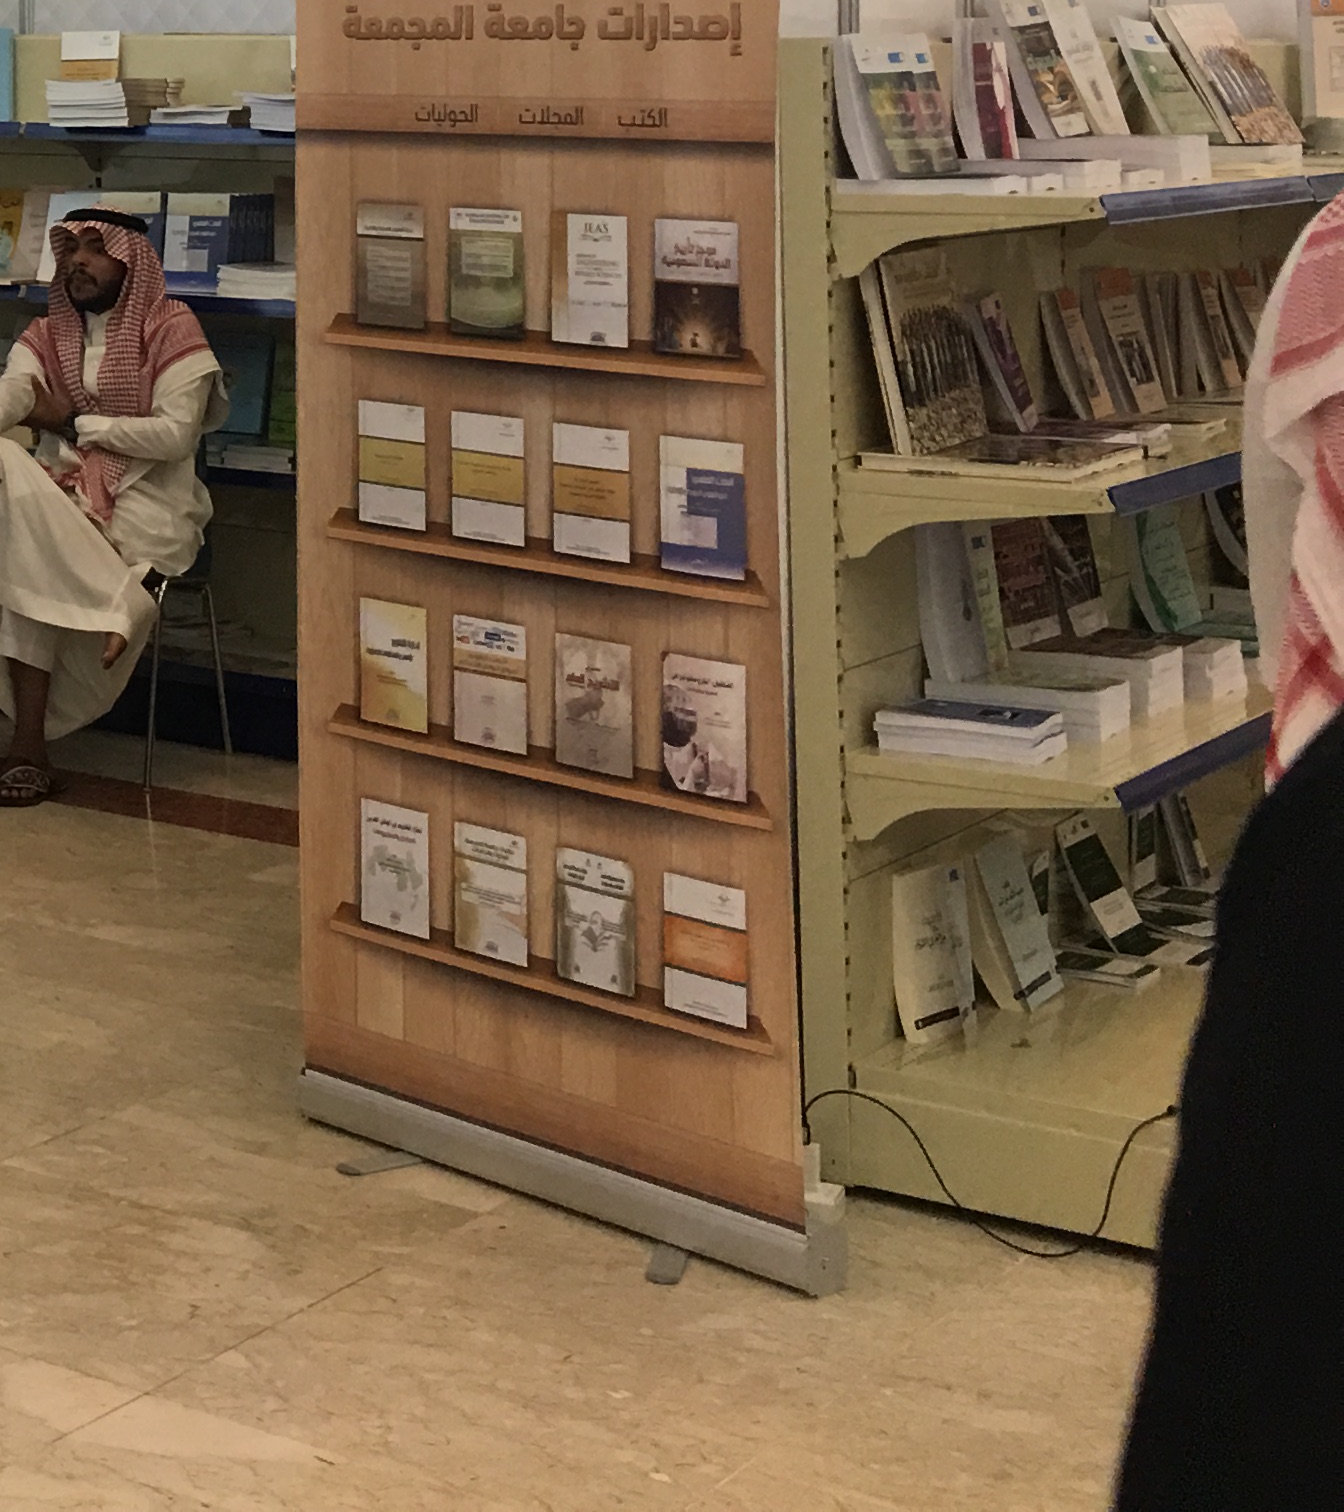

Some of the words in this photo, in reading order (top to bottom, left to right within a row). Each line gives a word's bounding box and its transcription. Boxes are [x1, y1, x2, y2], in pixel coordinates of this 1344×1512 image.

[341, 4, 475, 51] المجمعة
[483, 3, 587, 51] جامعة
[597, 2, 743, 57] إصدارات
[414, 104, 479, 128] الحوليات
[518, 106, 585, 127] المجلات
[617, 107, 668, 129] الكتب
